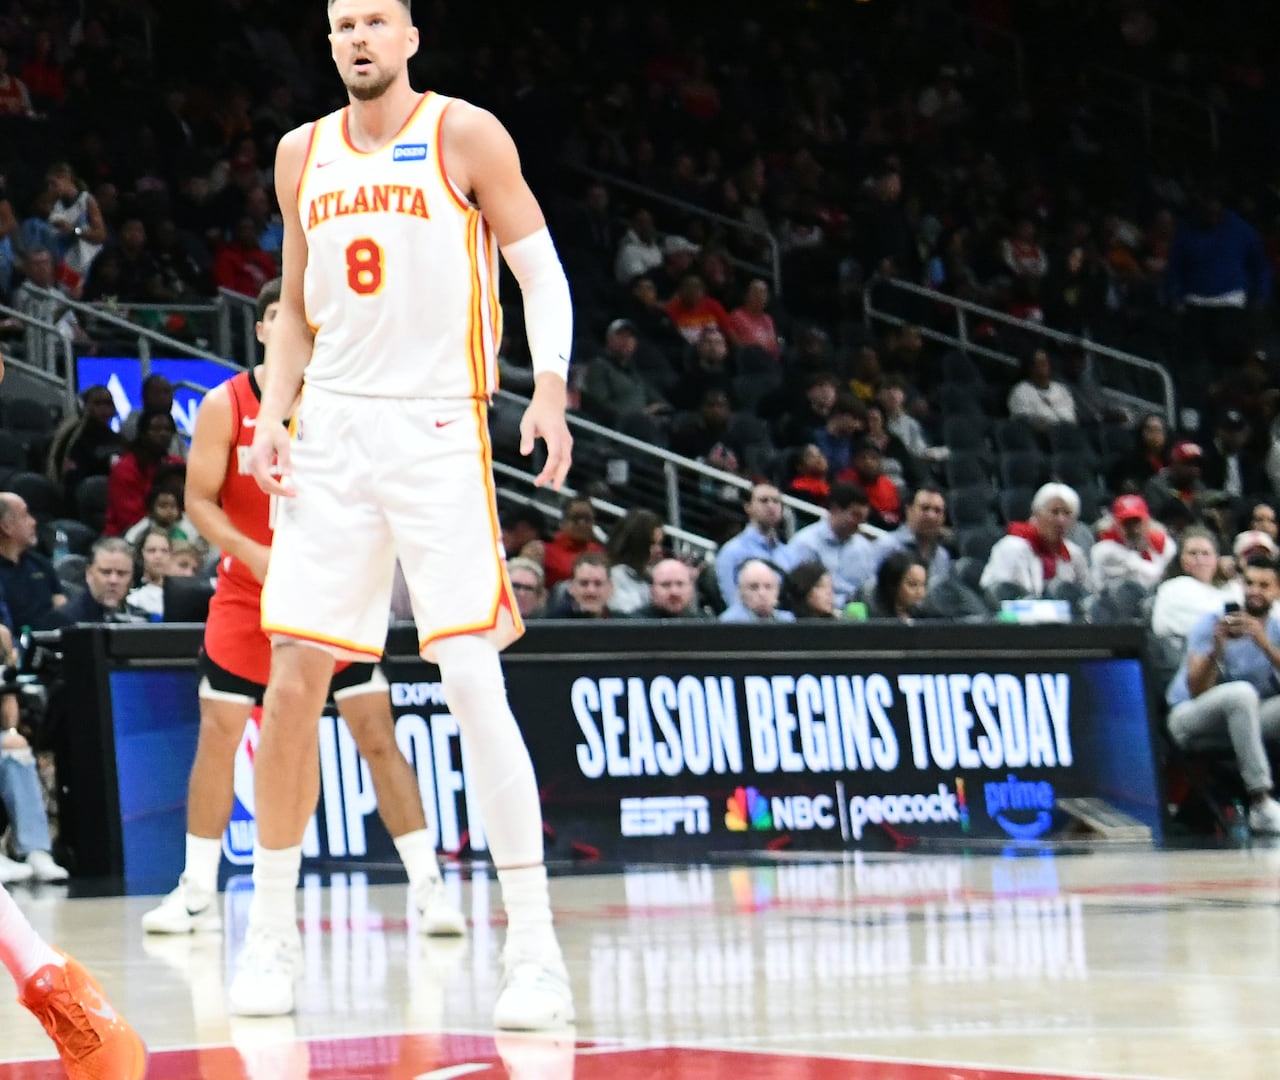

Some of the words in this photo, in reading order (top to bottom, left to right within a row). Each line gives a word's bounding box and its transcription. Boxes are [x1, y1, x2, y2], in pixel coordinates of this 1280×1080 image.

[308, 184, 431, 231] ATLANTA
[345, 237, 385, 296] 8
[570, 674, 744, 779] SEASON
[744, 673, 900, 774] BEGINS
[897, 671, 1074, 771] TUESDAY
[619, 795, 711, 837] ESPN
[771, 795, 837, 831] NBC
[849, 783, 960, 841] peacock
[984, 773, 1056, 818] prime
